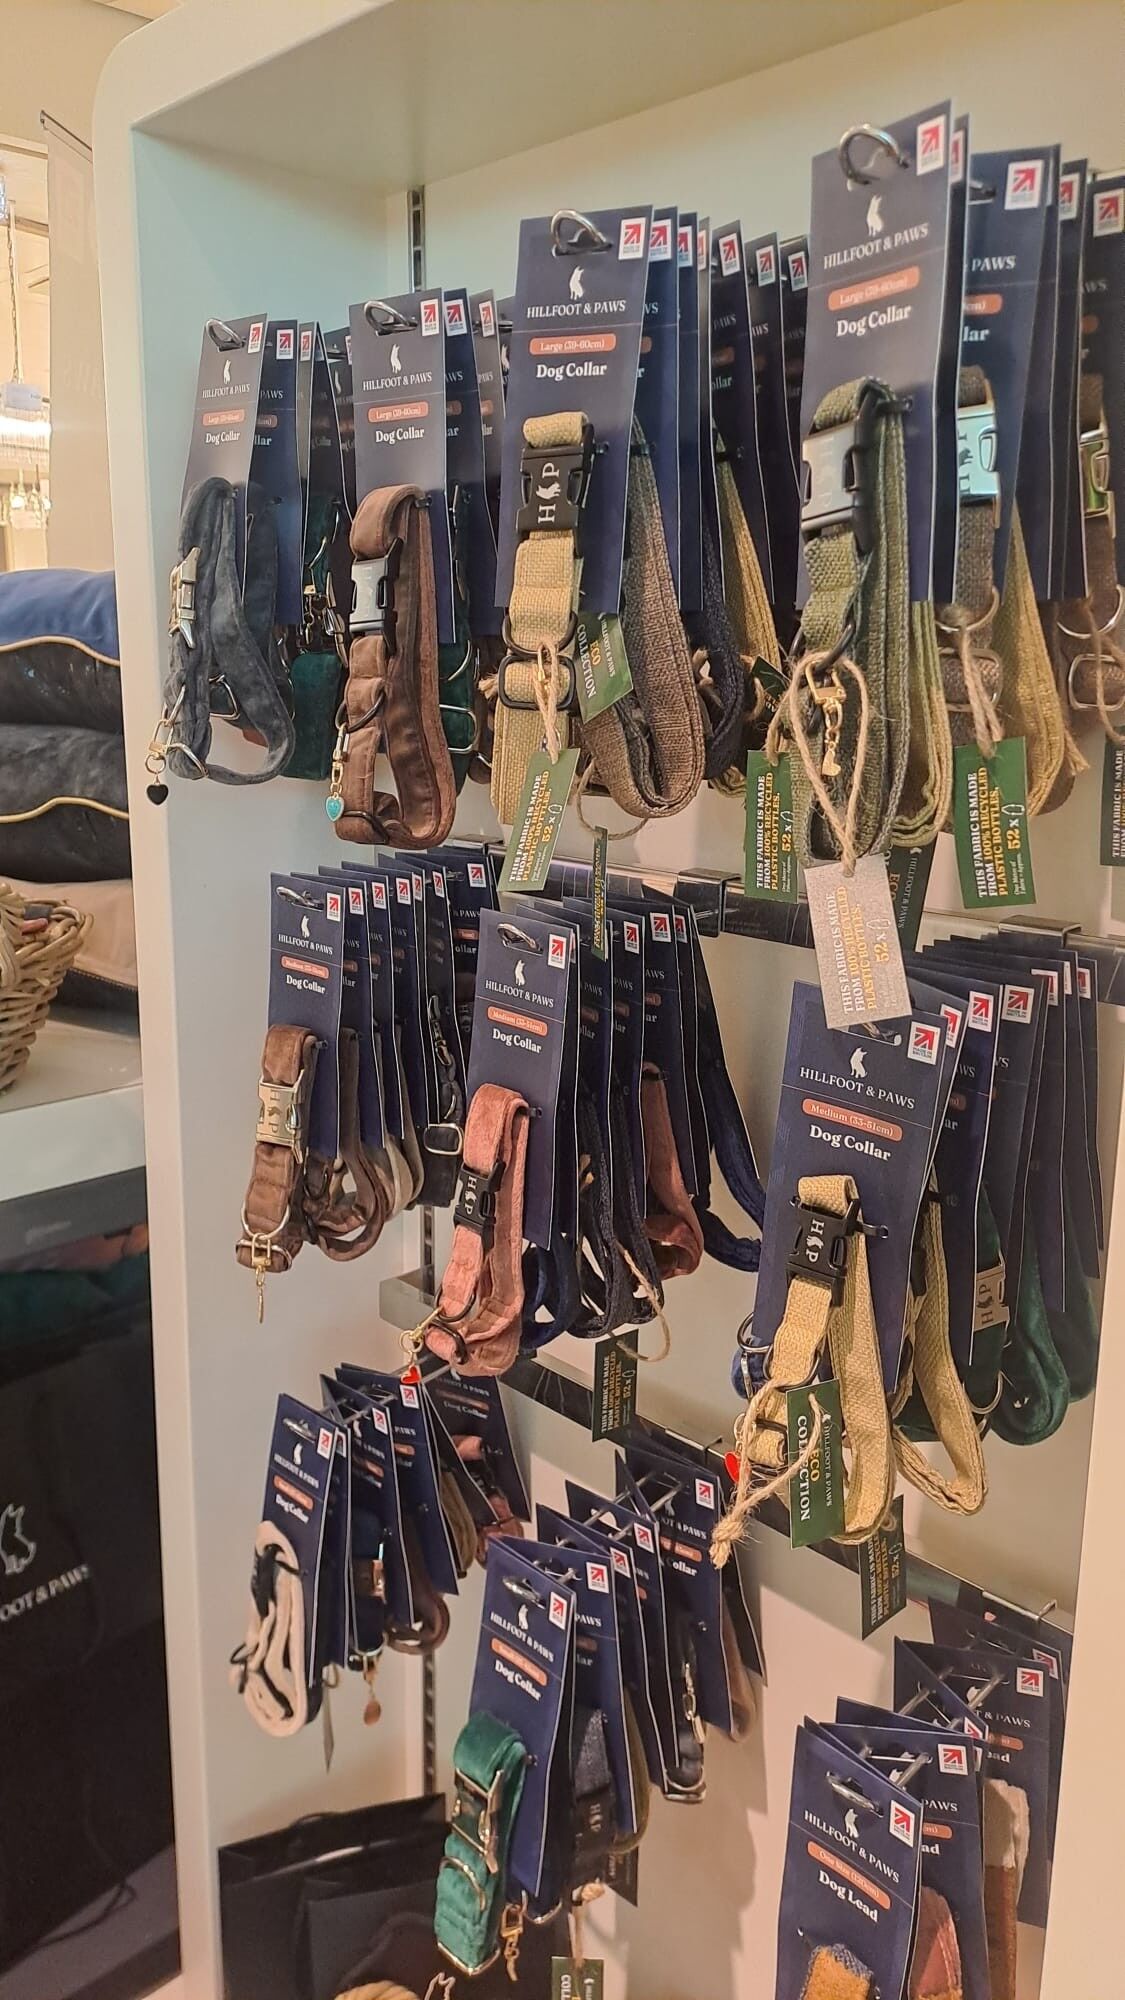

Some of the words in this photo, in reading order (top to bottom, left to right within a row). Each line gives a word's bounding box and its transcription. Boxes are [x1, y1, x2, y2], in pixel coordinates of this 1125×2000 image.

[824, 239, 882, 270] HILLFOOT
[883, 236, 892, 250] &
[894, 222, 929, 246] PAWS
[972, 255, 1016, 272] PAWS
[527, 303, 582, 318] HILLFOOT
[583, 303, 592, 314] &
[594, 300, 626, 314] PAWS
[836, 316, 866, 337] Dog
[868, 305, 912, 328] Collar
[540, 342, 562, 352] Large
[362, 376, 402, 391] HILLFOOT
[402, 375, 410, 386] &
[410, 372, 432, 384] PAWS
[536, 364, 564, 381] Dog
[566, 361, 608, 376] Collar
[202, 386, 230, 398] HILLFOOT
[234, 384, 250, 394] PAWS
[206, 433, 220, 446] Dog
[220, 431, 240, 442] Collar
[376, 430, 395, 444] Dog
[396, 426, 424, 439] Collar
[577, 624, 596, 698] COLLECTION
[590, 640, 601, 666] ECO
[1115, 750, 1124, 780] MADE
[757, 776, 766, 808] MADE
[765, 772, 773, 827] RECYCLED
[968, 772, 978, 808] MADE
[978, 768, 990, 830] RECYCLED
[508, 854, 521, 882] THIS
[517, 818, 532, 854] FABRIC
[530, 775, 542, 804] MADE
[516, 852, 529, 881] FROM
[532, 770, 550, 825] RECYCLED
[757, 810, 764, 820] IS
[970, 810, 979, 822] IS
[542, 824, 554, 842] 52
[782, 833, 792, 852] 52
[970, 823, 984, 868] FABRIC
[982, 830, 994, 862] 100%
[1008, 828, 1020, 850] 52
[1112, 833, 1120, 858] THIS
[522, 840, 539, 881] PLASTIC
[994, 846, 1008, 896] PLASTIC
[976, 869, 986, 898] THIS
[984, 863, 998, 896] FROM
[826, 894, 840, 926] MADE
[278, 934, 309, 950] HILLFOOT
[316, 943, 334, 956] PAWS
[832, 928, 841, 938] IS
[834, 940, 850, 984] FABRIC
[874, 942, 889, 962] 52
[286, 974, 302, 990] Dog
[303, 979, 326, 994] Collar
[646, 968, 665, 980] AWS
[860, 960, 878, 1009] PLASTIC
[486, 980, 524, 1000] HILLFOOT
[524, 992, 531, 1001] &
[532, 994, 554, 1008] PAWS
[840, 985, 854, 1014] THIS
[852, 979, 866, 1012] FROM
[492, 1028, 512, 1046] Dog
[514, 1034, 542, 1054] Collar
[800, 1066, 864, 1094] HILLFOOT
[866, 1086, 876, 1097] &
[878, 1088, 915, 1109] PAWS
[811, 1104, 848, 1122] Medium
[810, 1124, 842, 1148] Dog
[844, 1135, 892, 1160] Collar
[824, 1426, 832, 1472] HILLFOOT
[798, 1415, 811, 1520] COLCTION
[810, 1450, 820, 1482] ECO
[683, 1525, 707, 1540] PAWS
[672, 1558, 698, 1576] ollar
[490, 1612, 526, 1642] HILLFOOT
[534, 1641, 554, 1662] PAWS
[495, 1660, 514, 1684] Dog
[514, 1673, 541, 1701] Collar
[996, 1714, 1032, 1728] PAWS
[804, 1810, 858, 1852] HILLFOOT
[859, 1848, 867, 1860] &
[870, 1854, 900, 1883] PAWS
[819, 1870, 846, 1900] Dog
[848, 1889, 878, 1923] Lead
